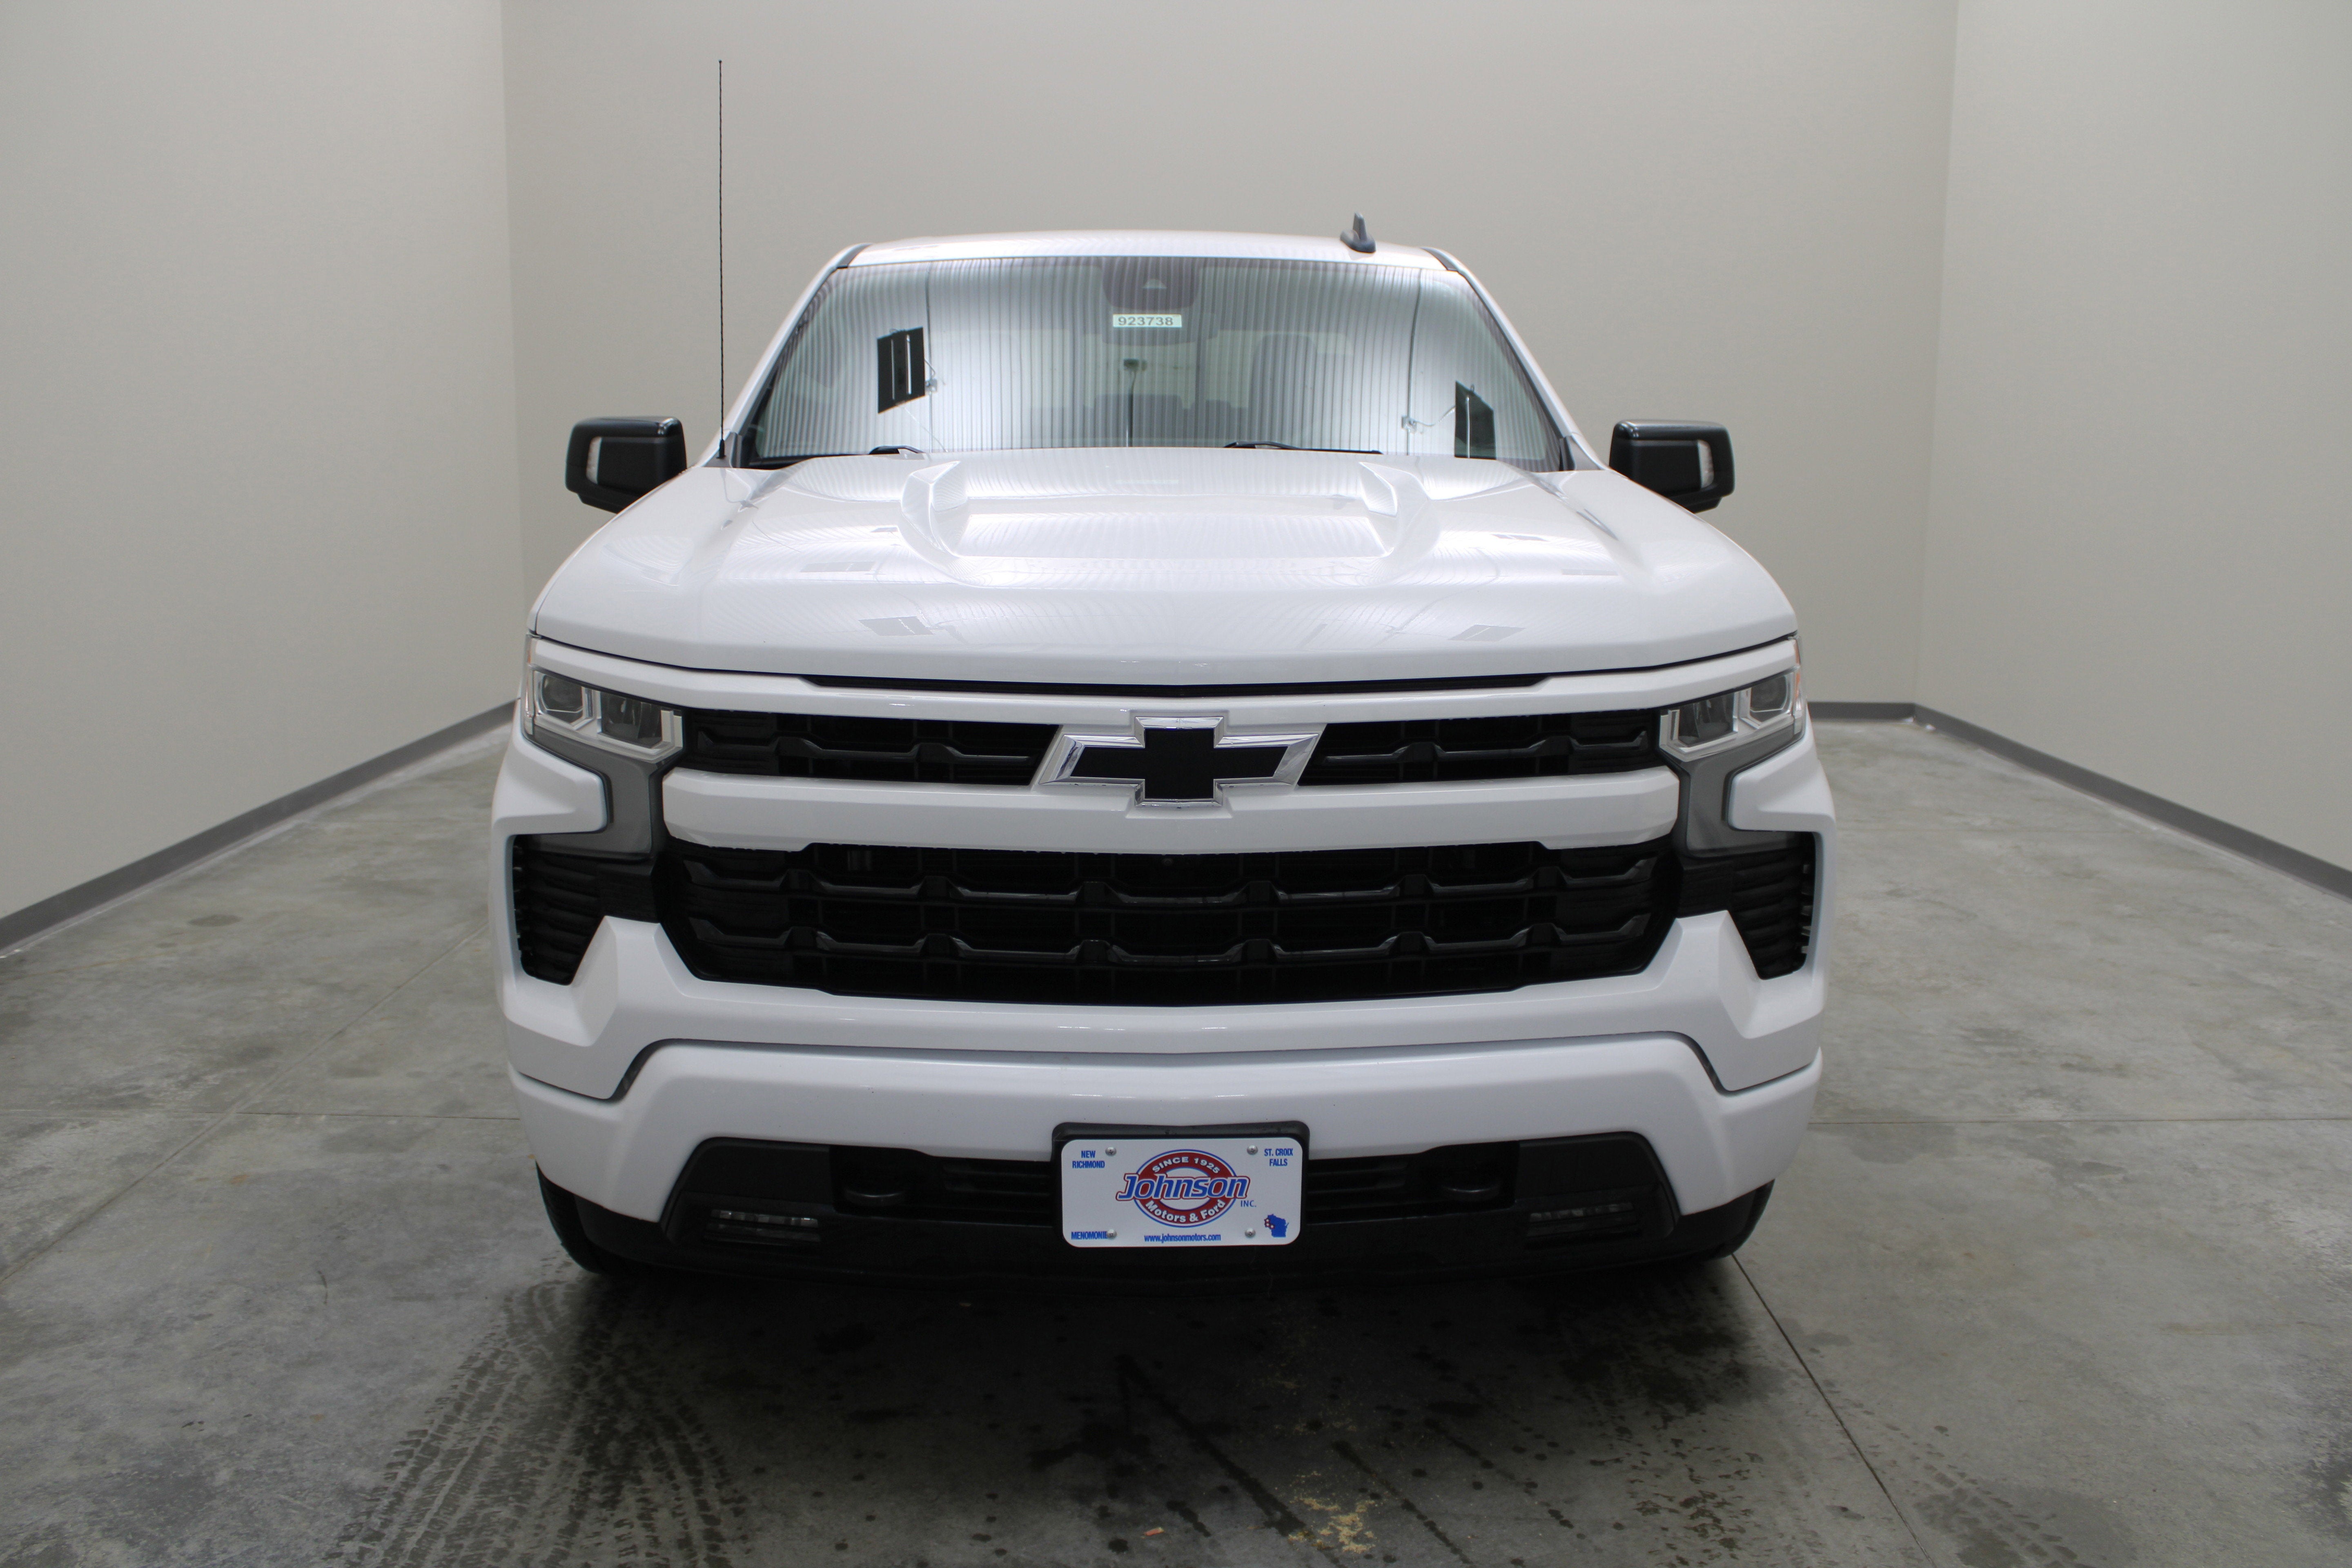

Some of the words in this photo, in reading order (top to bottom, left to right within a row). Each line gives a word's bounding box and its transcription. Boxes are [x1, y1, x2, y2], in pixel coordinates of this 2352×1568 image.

[1118, 316, 1173, 325] 923738
[1152, 1156, 1189, 1173] SINCE
[1194, 1158, 1220, 1174] 1925
[1117, 1174, 1249, 1200] Johnson
[1145, 1200, 1186, 1223] Motors
[1189, 1212, 1199, 1222] &
[1200, 1200, 1225, 1219] Ford
[1144, 1234, 1221, 1243] www.johnsonmotors.com
